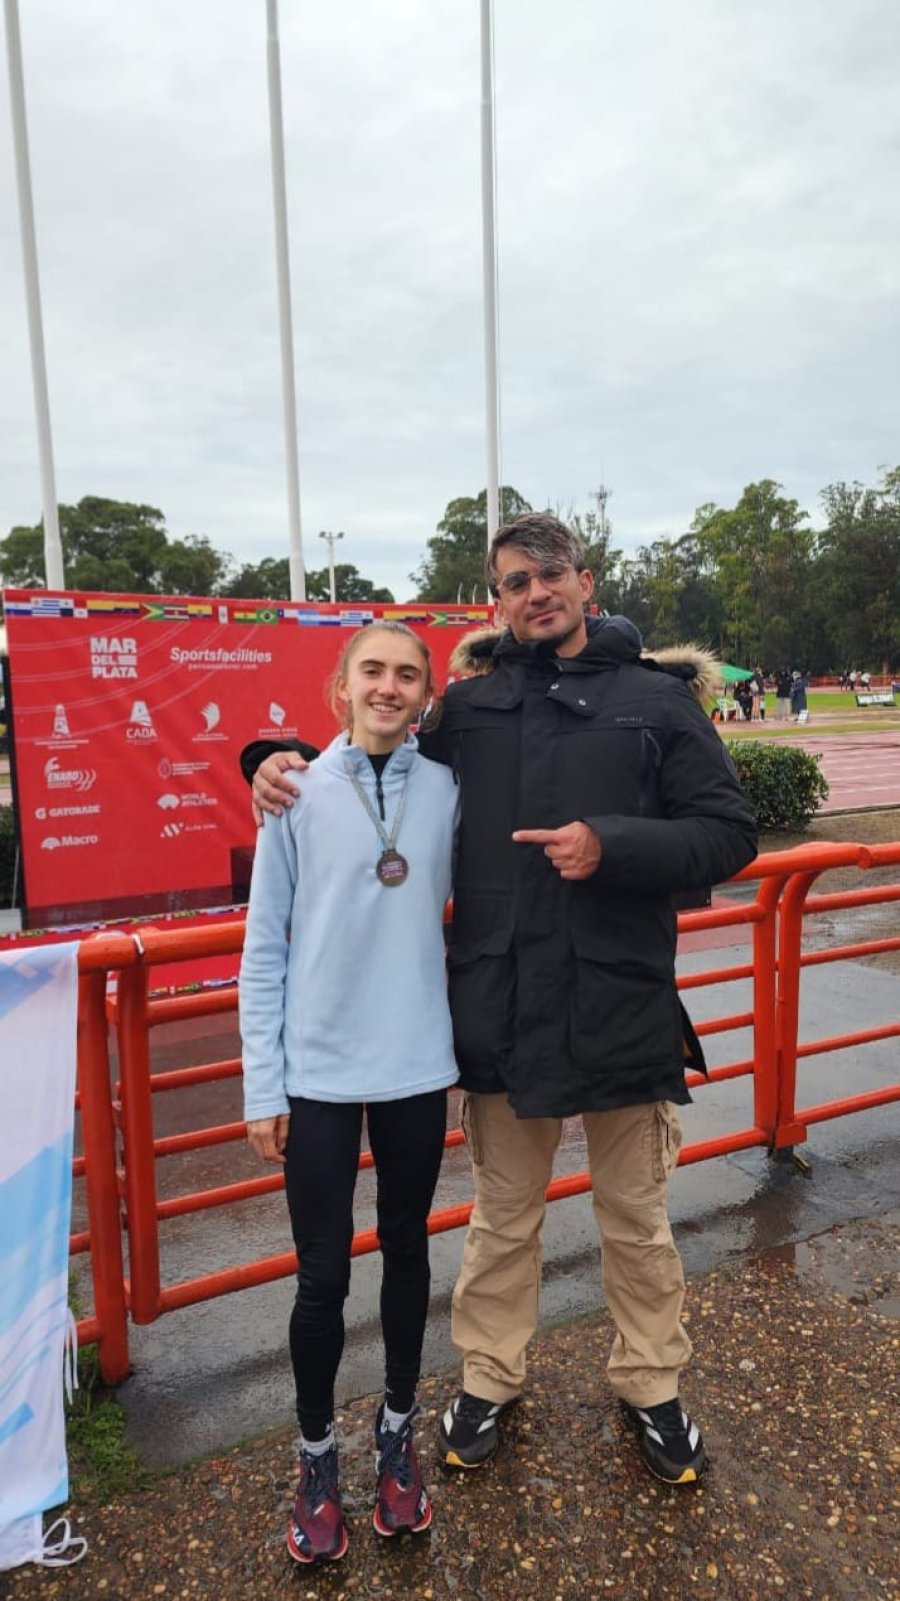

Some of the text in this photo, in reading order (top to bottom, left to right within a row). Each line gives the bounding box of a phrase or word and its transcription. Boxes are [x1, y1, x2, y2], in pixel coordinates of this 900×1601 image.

[90, 636, 137, 654] MAR
[91, 655, 117, 665] DEL
[170, 647, 272, 663] Sportsfacilities
[92, 667, 138, 679] PLATA
[126, 727, 157, 739] CADA
[49, 804, 101, 817] GATORADE
[61, 834, 98, 847] Macro
